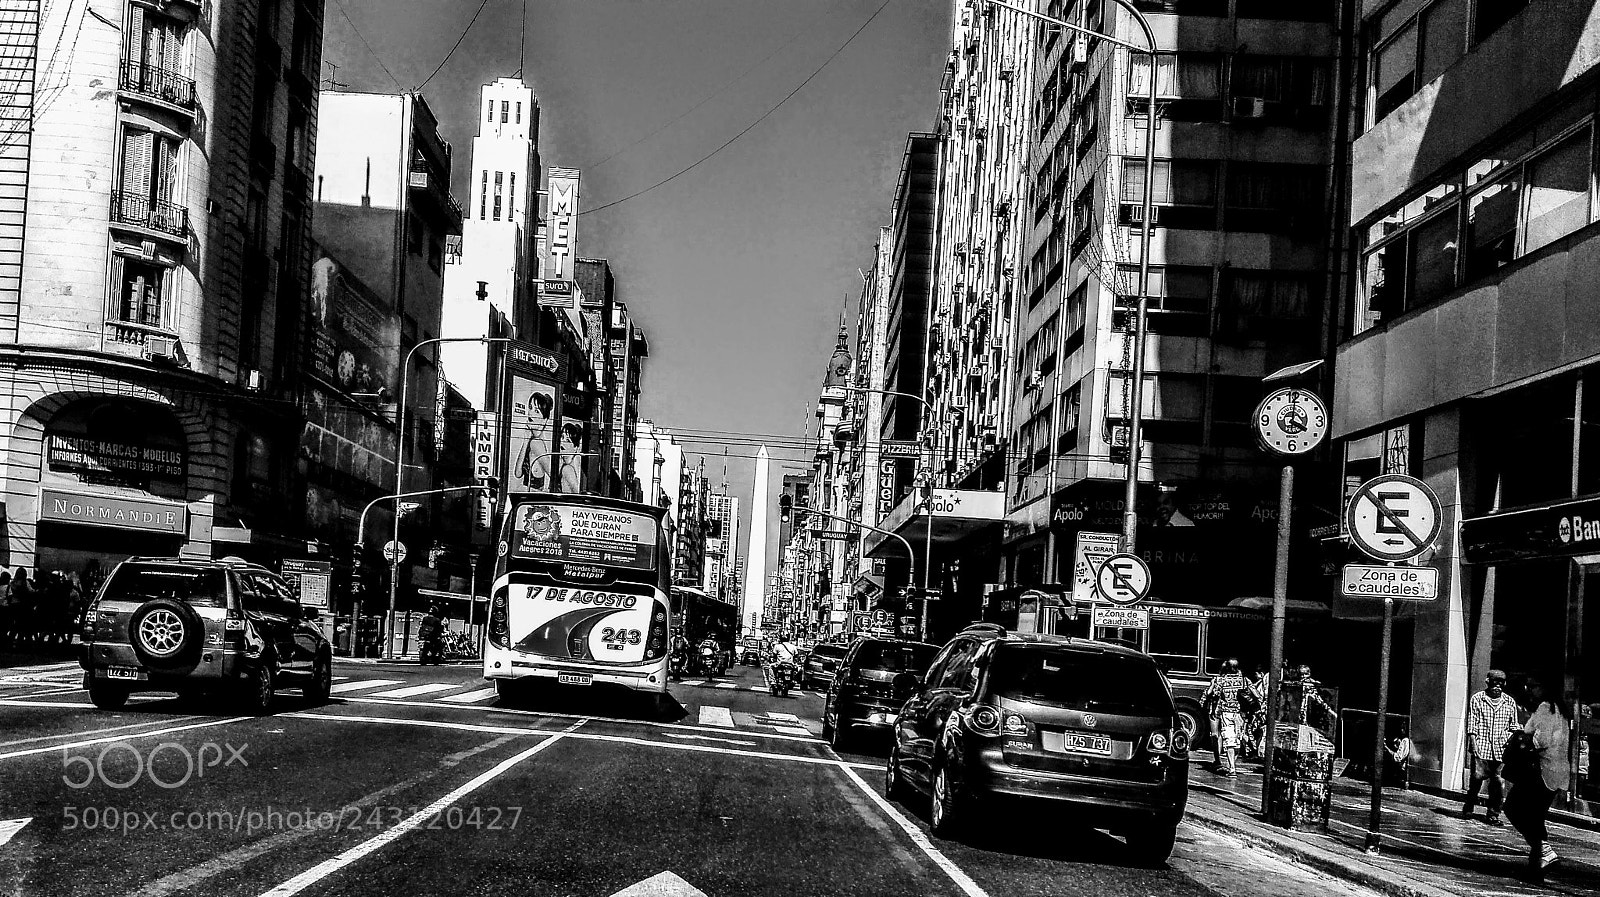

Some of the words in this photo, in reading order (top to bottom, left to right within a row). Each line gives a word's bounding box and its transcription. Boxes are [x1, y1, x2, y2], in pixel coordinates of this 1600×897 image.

[551, 182, 573, 278] MET
[545, 282, 563, 291] sura
[1286, 391, 1301, 404] 12
[1260, 414, 1270, 427] 9
[1315, 415, 1324, 428] 3
[881, 444, 920, 455] PIZZERIA
[1287, 439, 1297, 452] 6
[53, 498, 177, 526] NORMANDIE
[572, 510, 590, 519] HAY
[591, 512, 632, 524] VERANOS
[1054, 507, 1083, 523] Apolo
[571, 519, 590, 528] QUE
[590, 521, 621, 531] DURAN
[570, 527, 594, 537] PARA
[595, 530, 631, 541] SIEMPRE
[523, 538, 562, 549] Vacaciones
[519, 545, 543, 554] Alegres
[545, 548, 562, 556] 2018
[563, 563, 606, 574] Mercedes-Benz
[563, 570, 605, 579] Metalpar
[1361, 568, 1396, 581] Zona
[1401, 569, 1418, 582] de
[1359, 581, 1420, 595] caudales
[526, 586, 543, 599] 17
[545, 588, 568, 602] DE
[569, 590, 637, 609] AGOSTO
[876, 611, 884, 620] E
[1104, 610, 1125, 618] Zona
[1127, 610, 1138, 618] de
[862, 617, 869, 626] E
[1102, 618, 1139, 627] caudales
[601, 627, 641, 645] 243
[1067, 734, 1086, 747] HZS
[1091, 737, 1109, 750] 737
